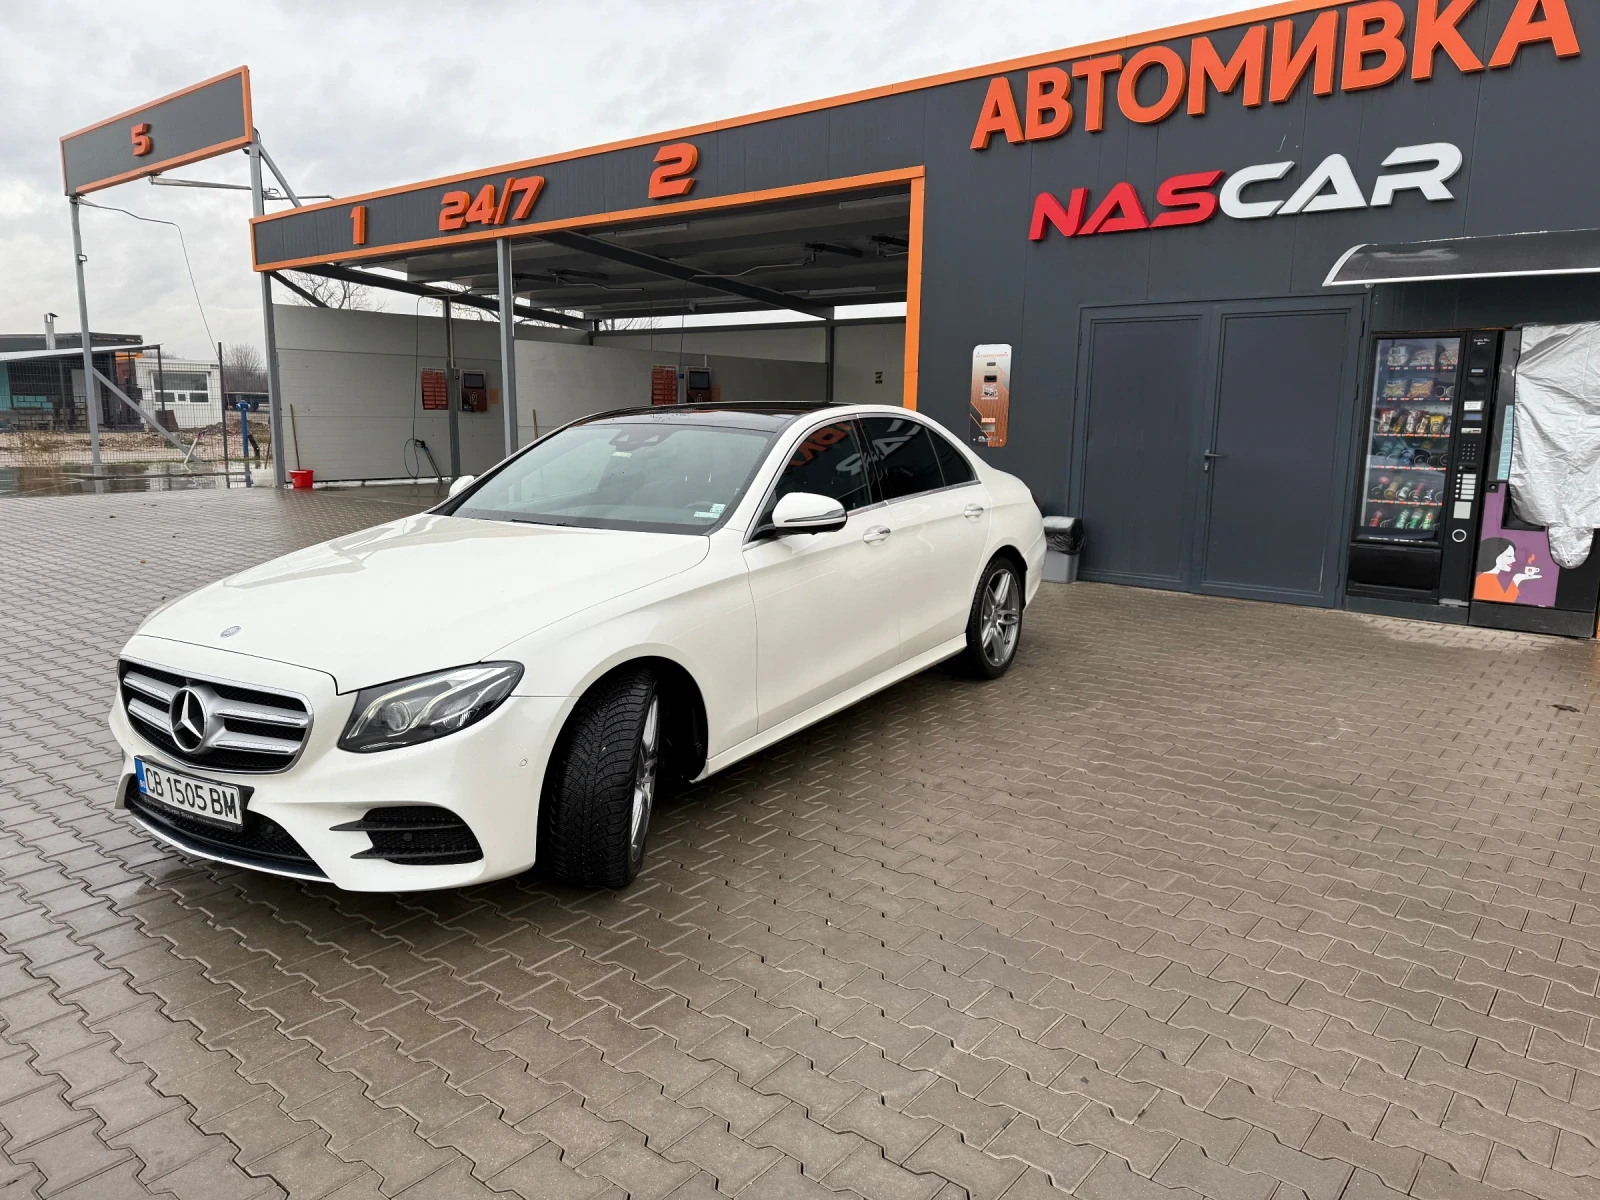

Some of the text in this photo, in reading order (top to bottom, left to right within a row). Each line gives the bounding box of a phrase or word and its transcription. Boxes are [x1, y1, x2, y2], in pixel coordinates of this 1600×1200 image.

[969, 0, 1582, 151] АВТОМИВКА
[130, 122, 153, 157] 5
[647, 141, 699, 199] 2
[1028, 142, 1464, 241] NASCAR
[349, 205, 367, 246] 1
[438, 175, 546, 232] 24/7
[145, 767, 238, 820] CB 1505 BM
